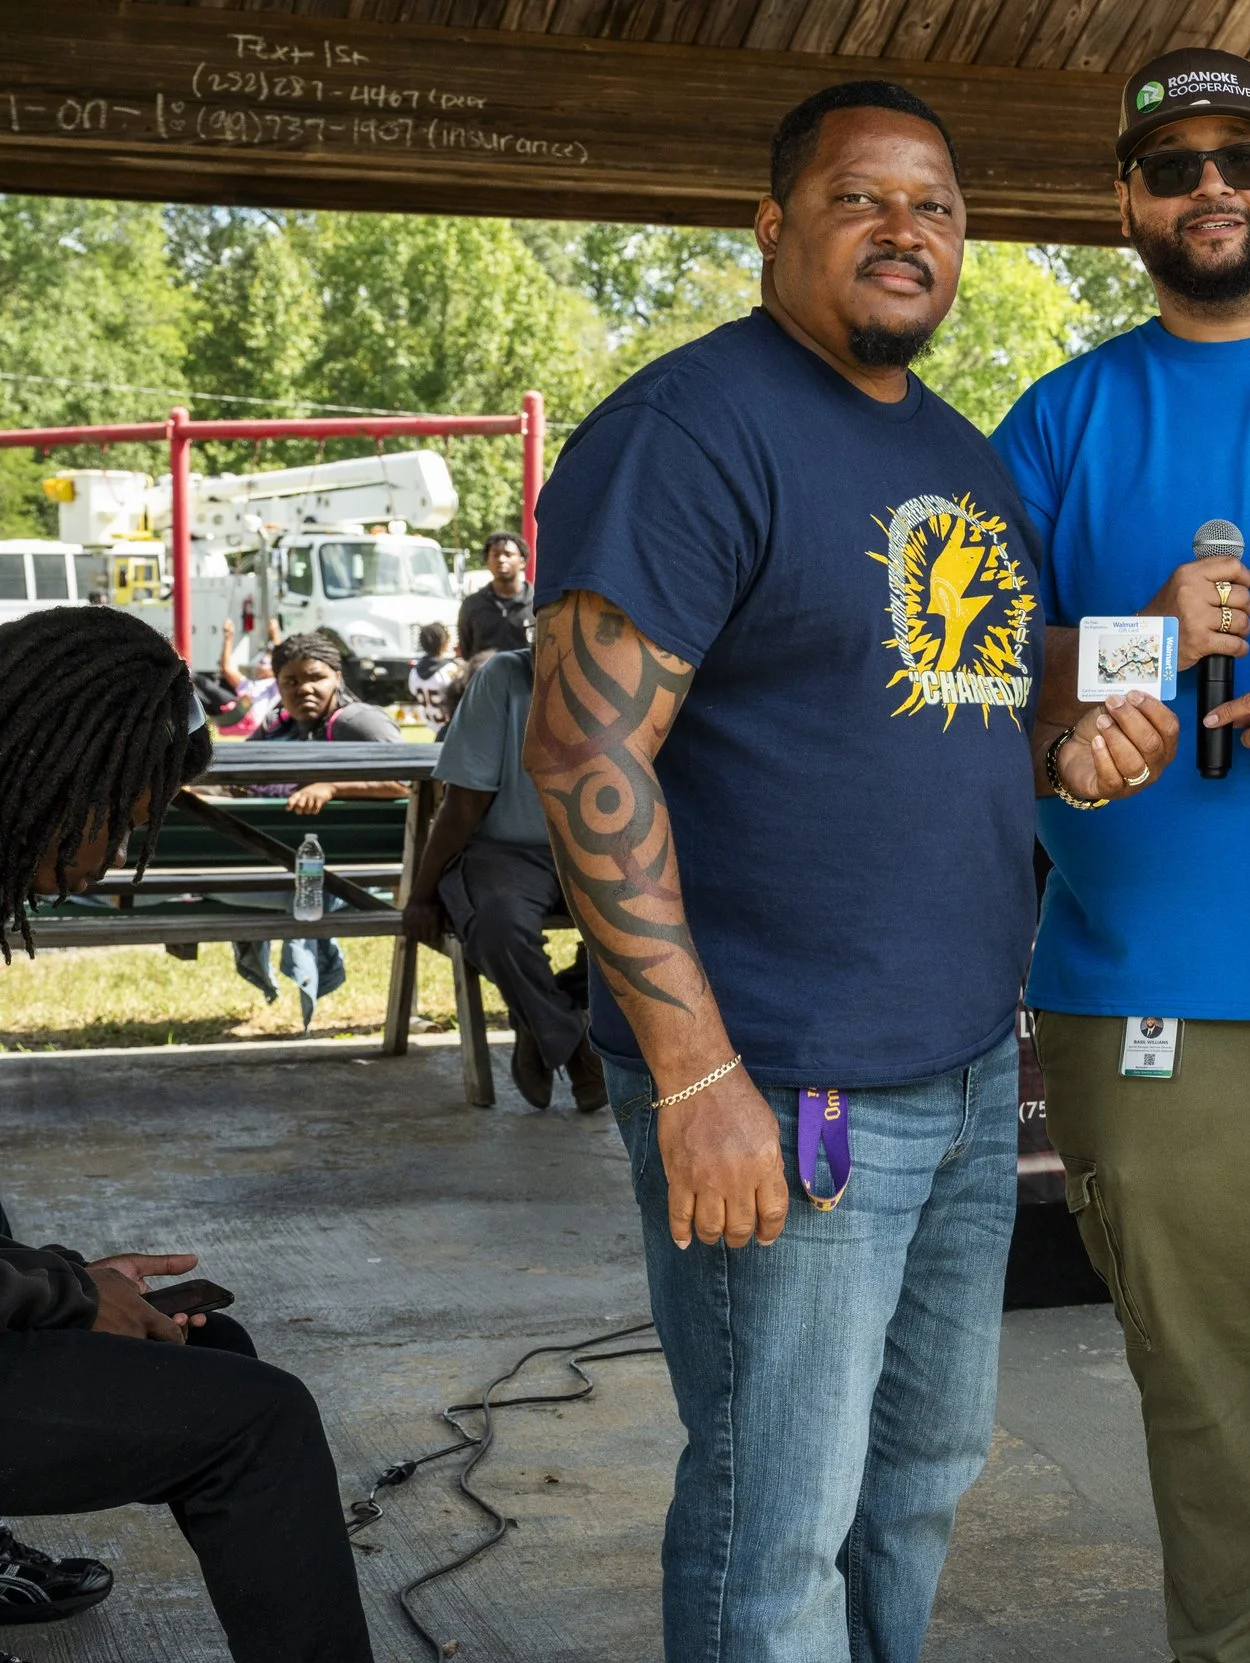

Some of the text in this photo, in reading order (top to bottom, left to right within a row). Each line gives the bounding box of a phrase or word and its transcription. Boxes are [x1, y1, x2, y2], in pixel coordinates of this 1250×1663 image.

[227, 33, 314, 65] Text
[1168, 71, 1239, 88] ROANOKE
[427, 118, 590, 164] (insurance)
[1166, 636, 1174, 670] Walmart
[908, 670, 1015, 706] "CHARGED
